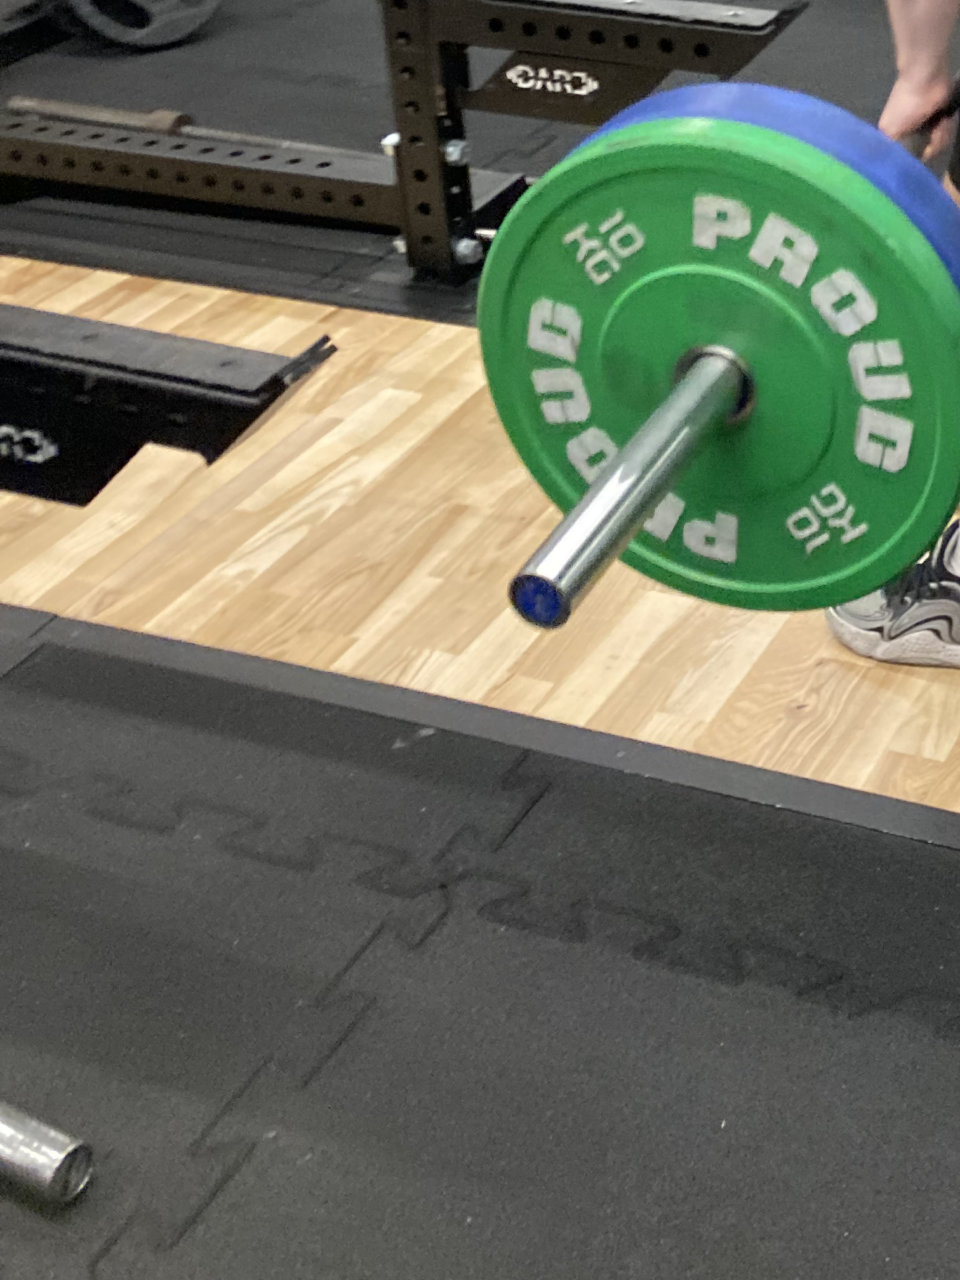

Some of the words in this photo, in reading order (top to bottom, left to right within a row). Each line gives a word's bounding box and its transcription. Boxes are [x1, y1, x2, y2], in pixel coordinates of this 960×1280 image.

[562, 222, 621, 285] KG
[598, 208, 646, 258] 10
[692, 193, 914, 474] PROUD
[785, 506, 830, 555] 10
[810, 482, 869, 544] KG
